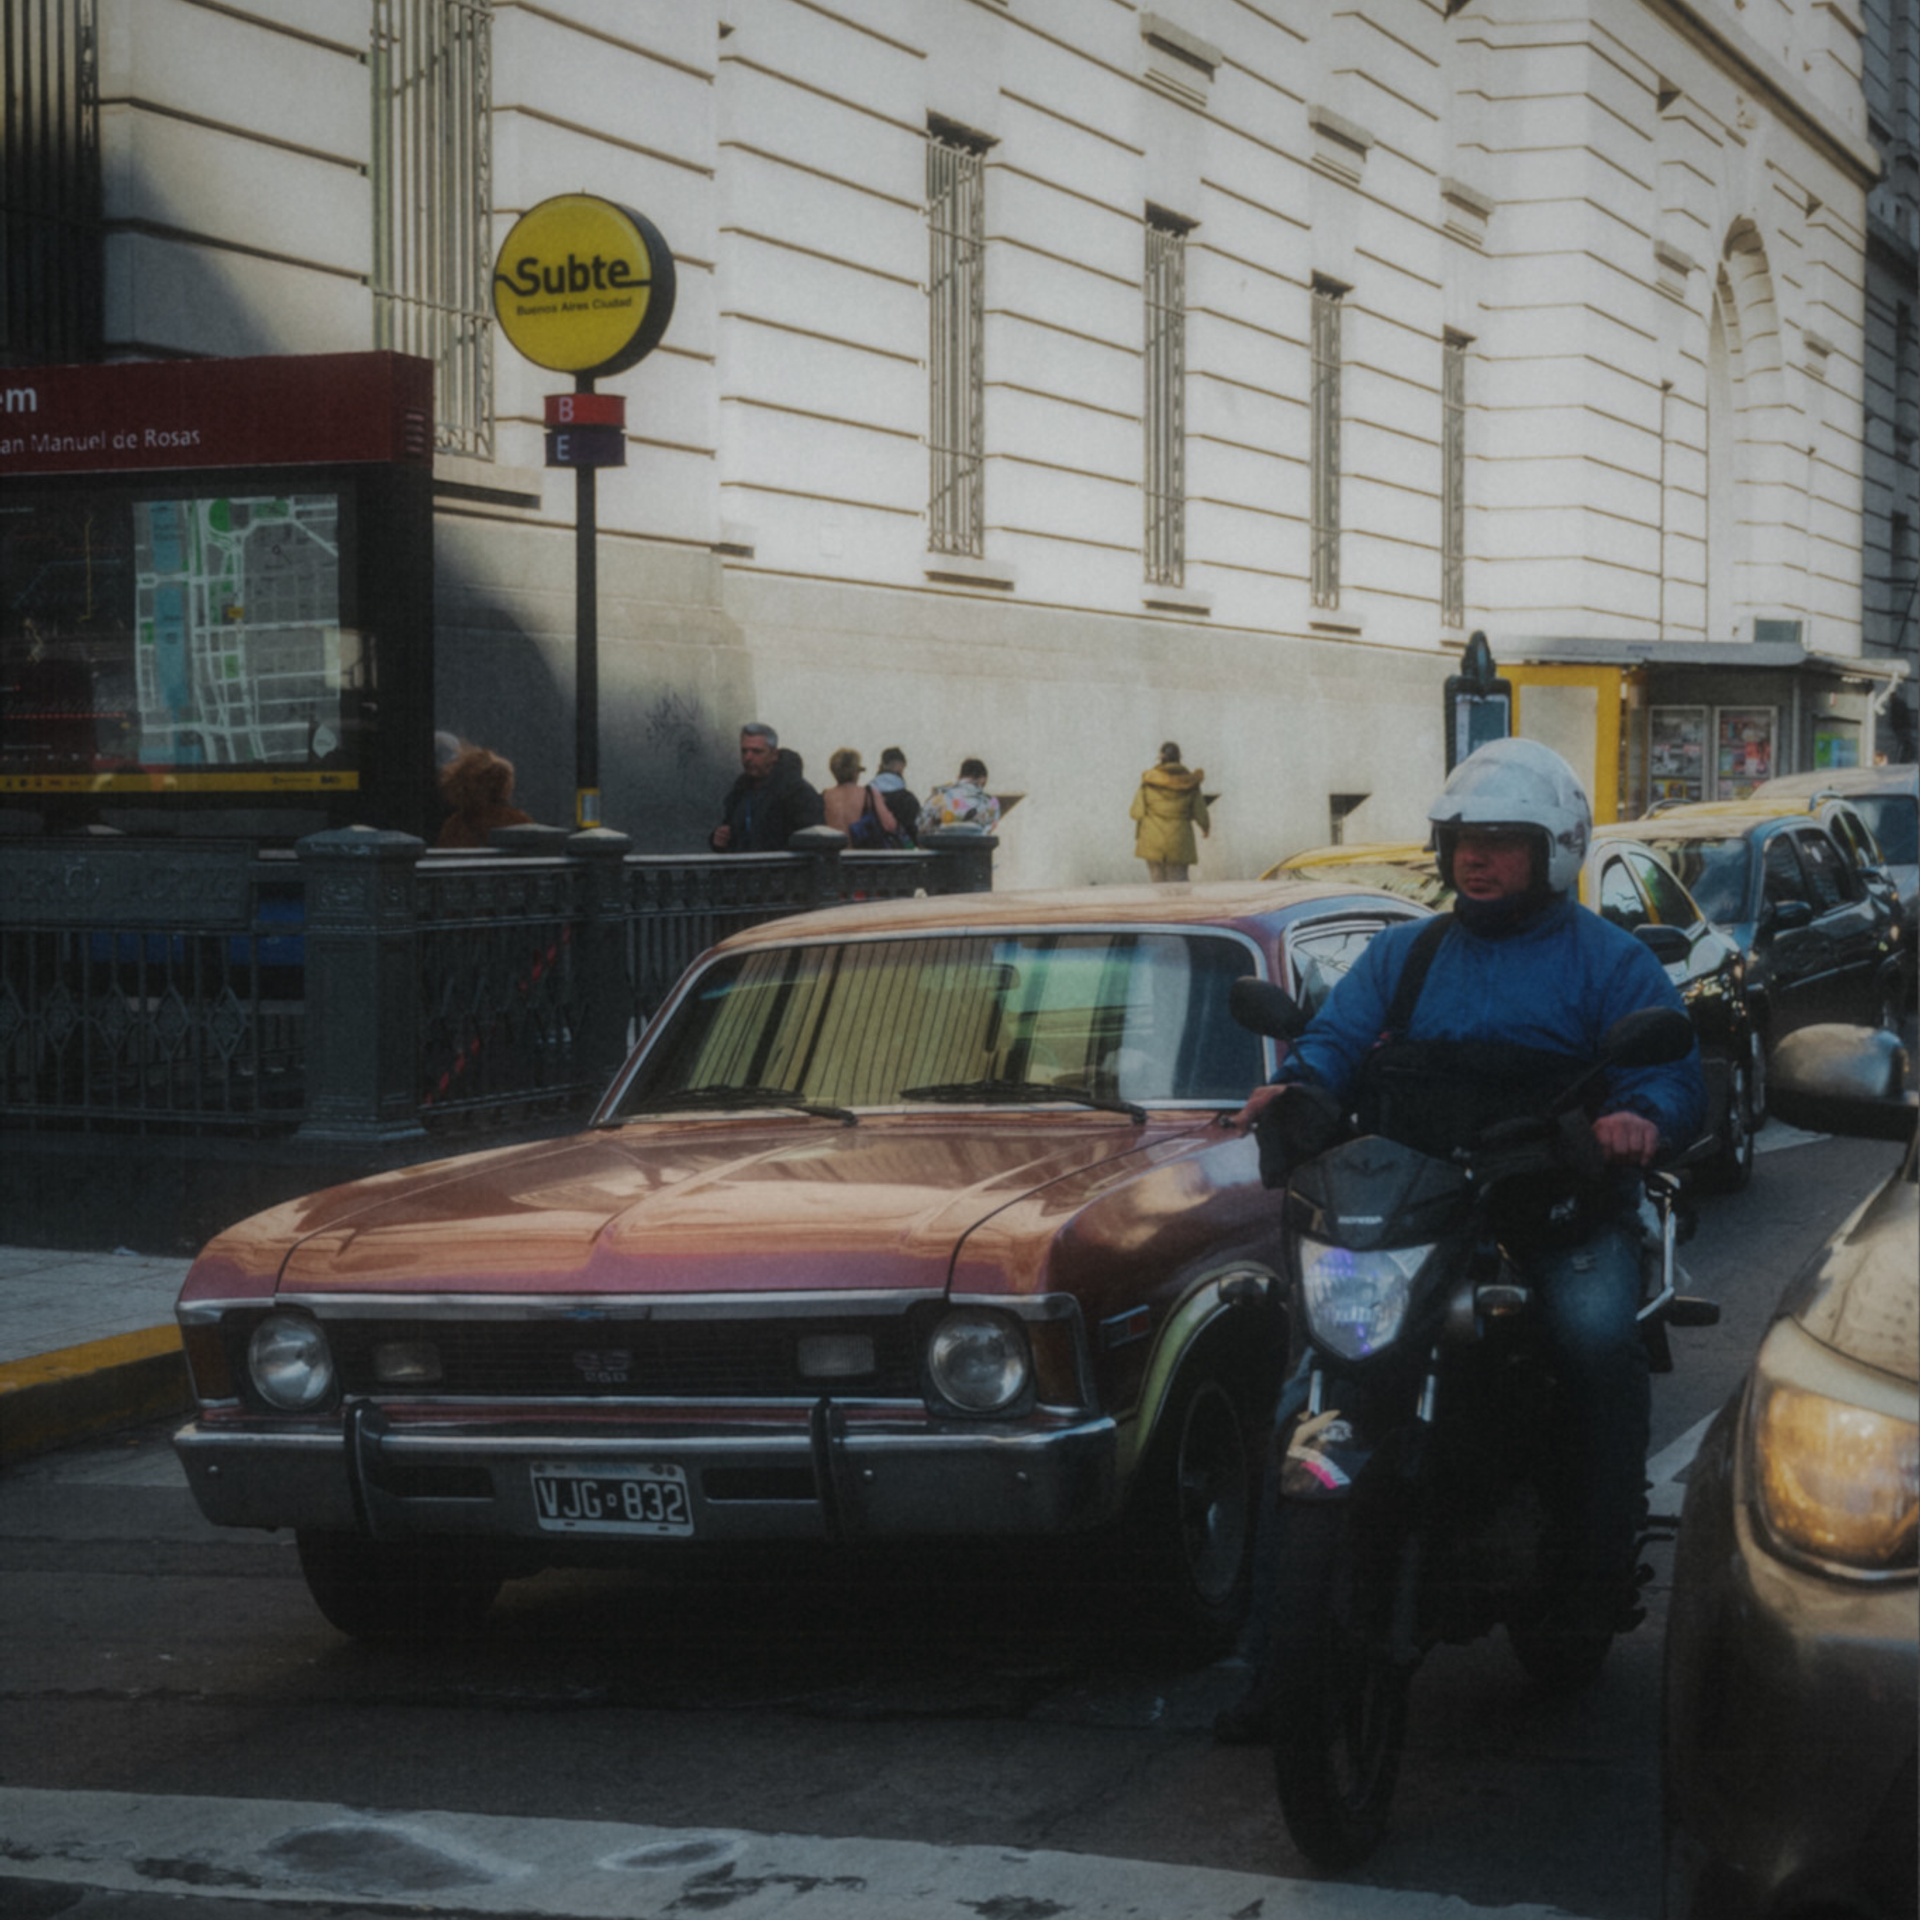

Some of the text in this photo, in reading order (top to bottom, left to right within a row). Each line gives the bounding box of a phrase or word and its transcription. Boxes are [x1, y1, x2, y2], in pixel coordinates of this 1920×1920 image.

[513, 253, 633, 298] Subte
[516, 296, 633, 316] Buenos Aires Ciudad
[0, 386, 38, 413] m
[558, 397, 574, 423] B
[31, 429, 106, 453] Manuel
[112, 428, 138, 450] de
[143, 428, 201, 448] Rosas
[556, 435, 571, 461] E
[537, 1478, 686, 1523] VJG 832
